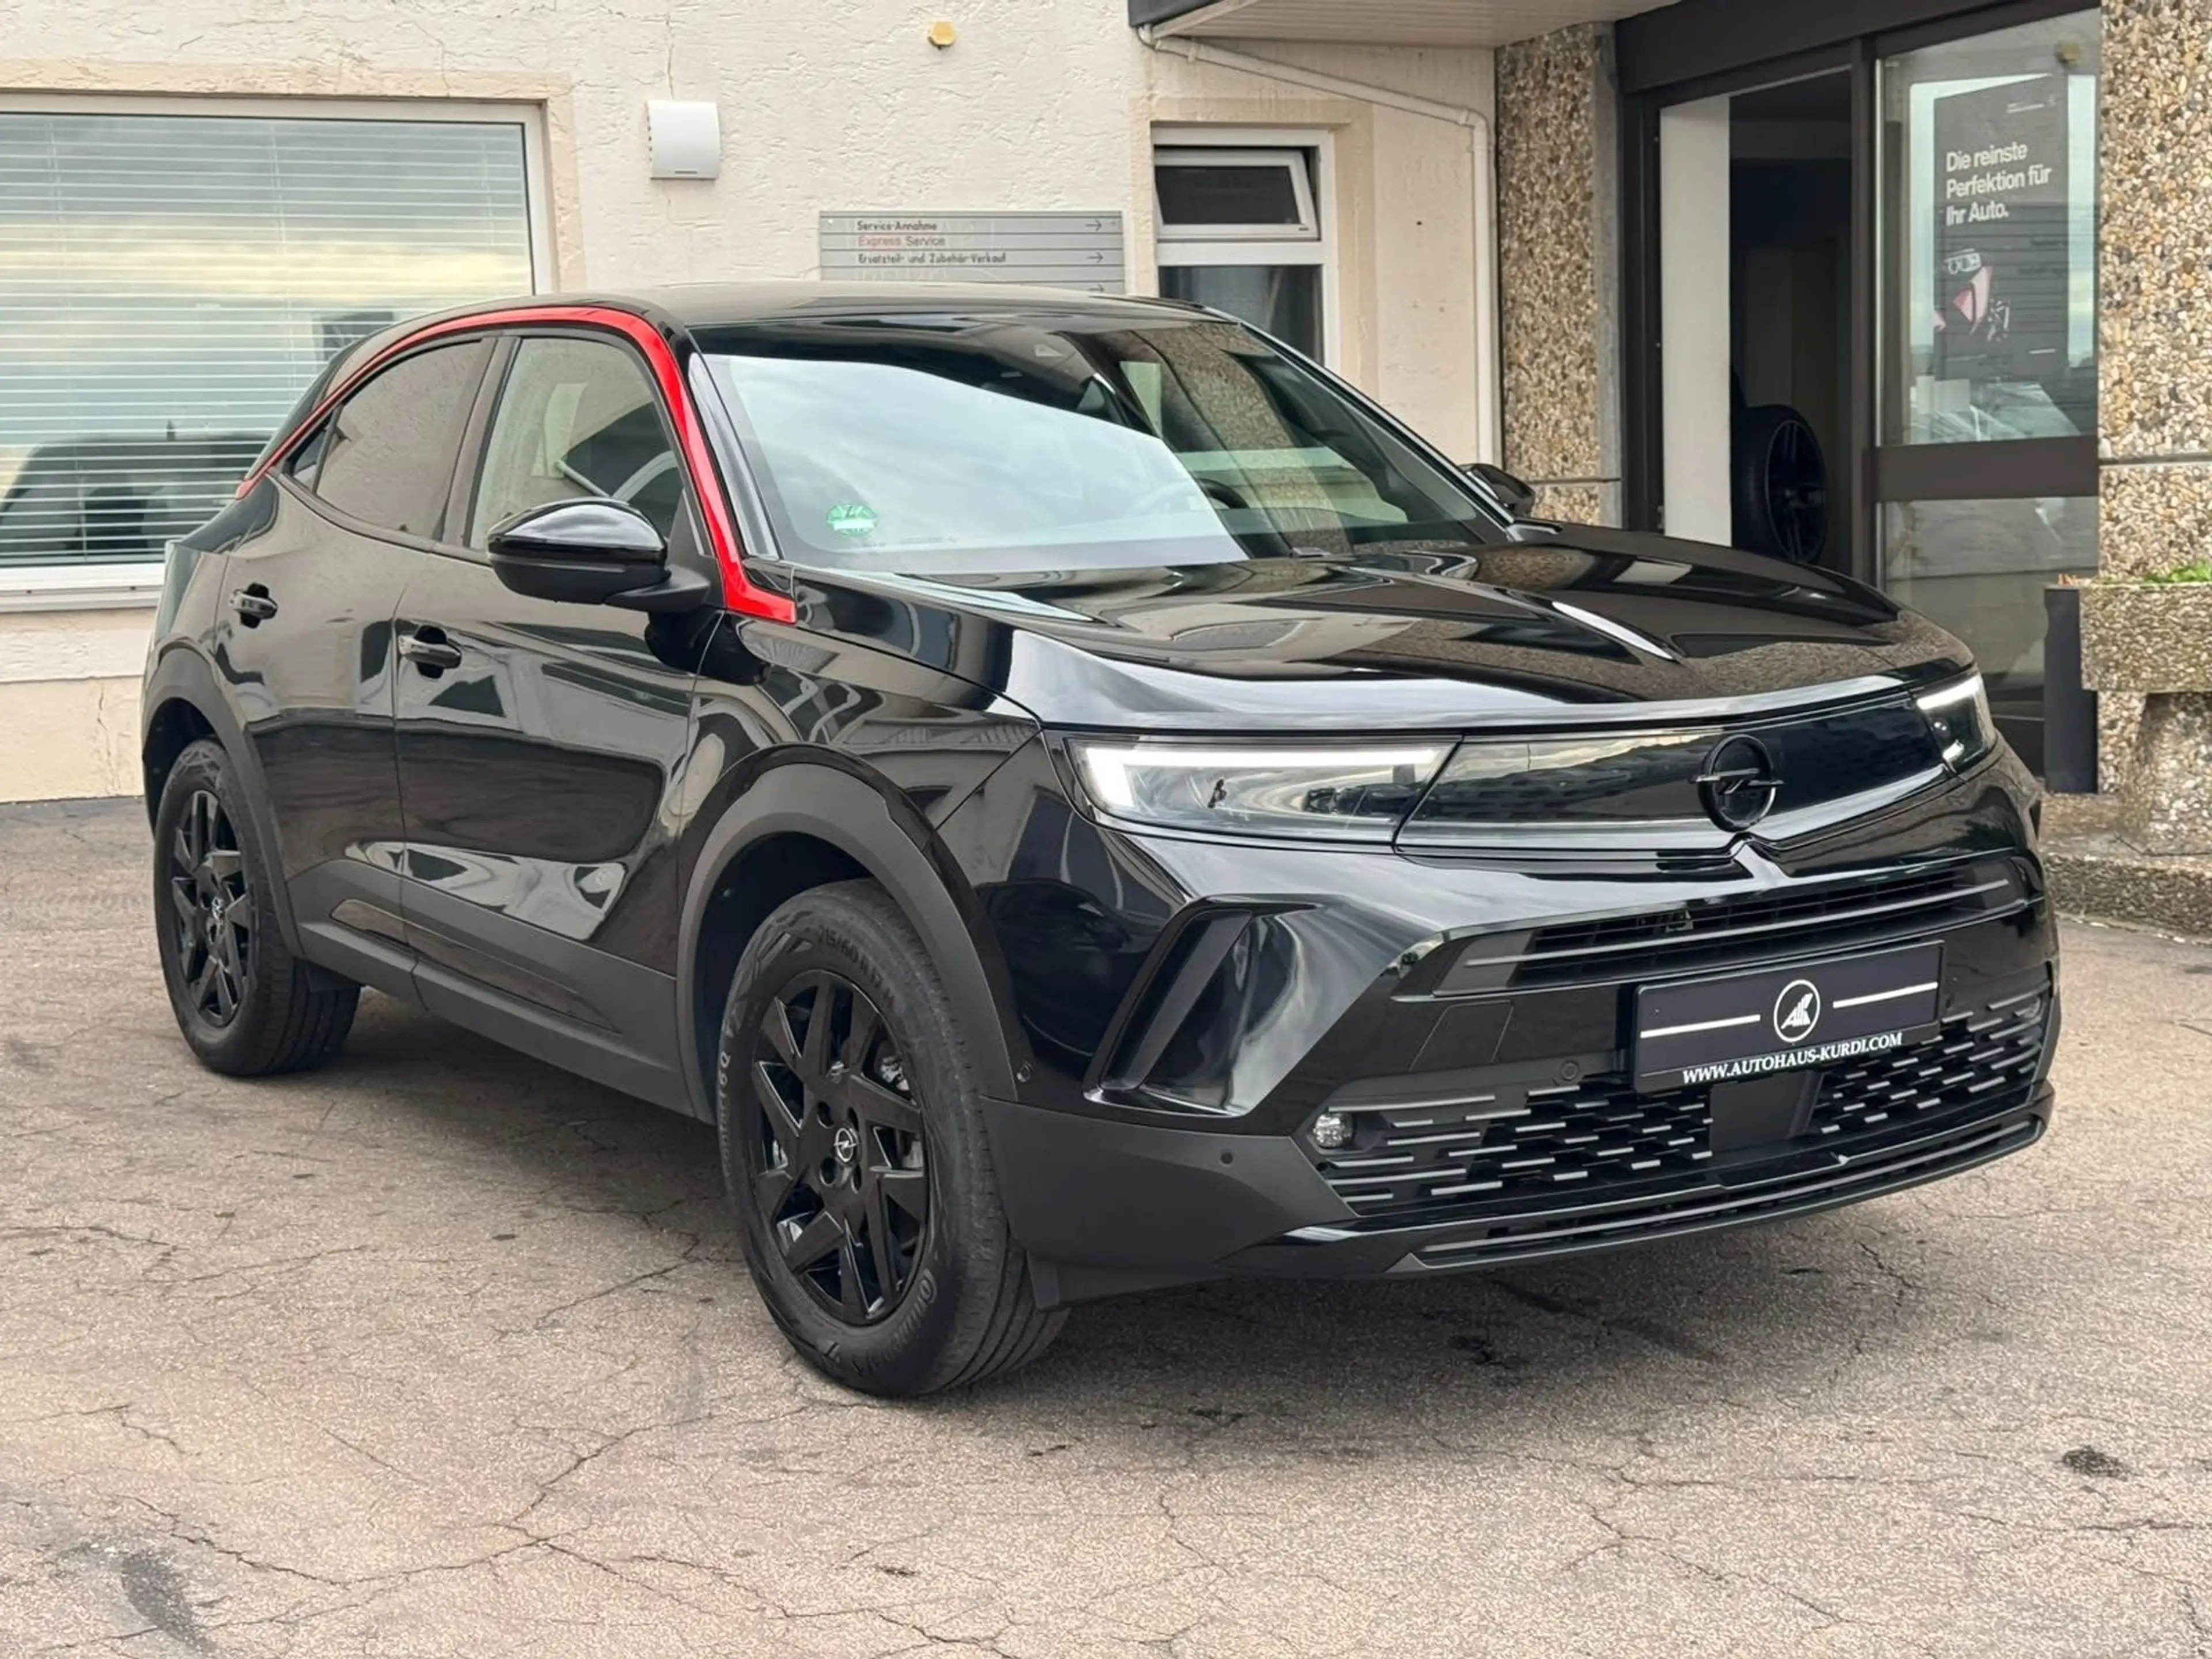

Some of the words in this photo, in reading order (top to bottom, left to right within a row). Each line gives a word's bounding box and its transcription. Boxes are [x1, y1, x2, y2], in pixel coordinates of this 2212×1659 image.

[1946, 150, 1972, 172] Die
[1974, 142, 2028, 168] reinste
[1946, 170, 2025, 199] Perfektion
[2028, 164, 2052, 187] für
[1946, 205, 1966, 226] Ihr
[1968, 200, 2009, 222] Auto.
[858, 236, 902, 248] Express
[905, 236, 946, 247] Service
[908, 253, 925, 263] und
[1682, 1033, 1903, 1085] WWW.AUTOHAUS-KURDI.COM
